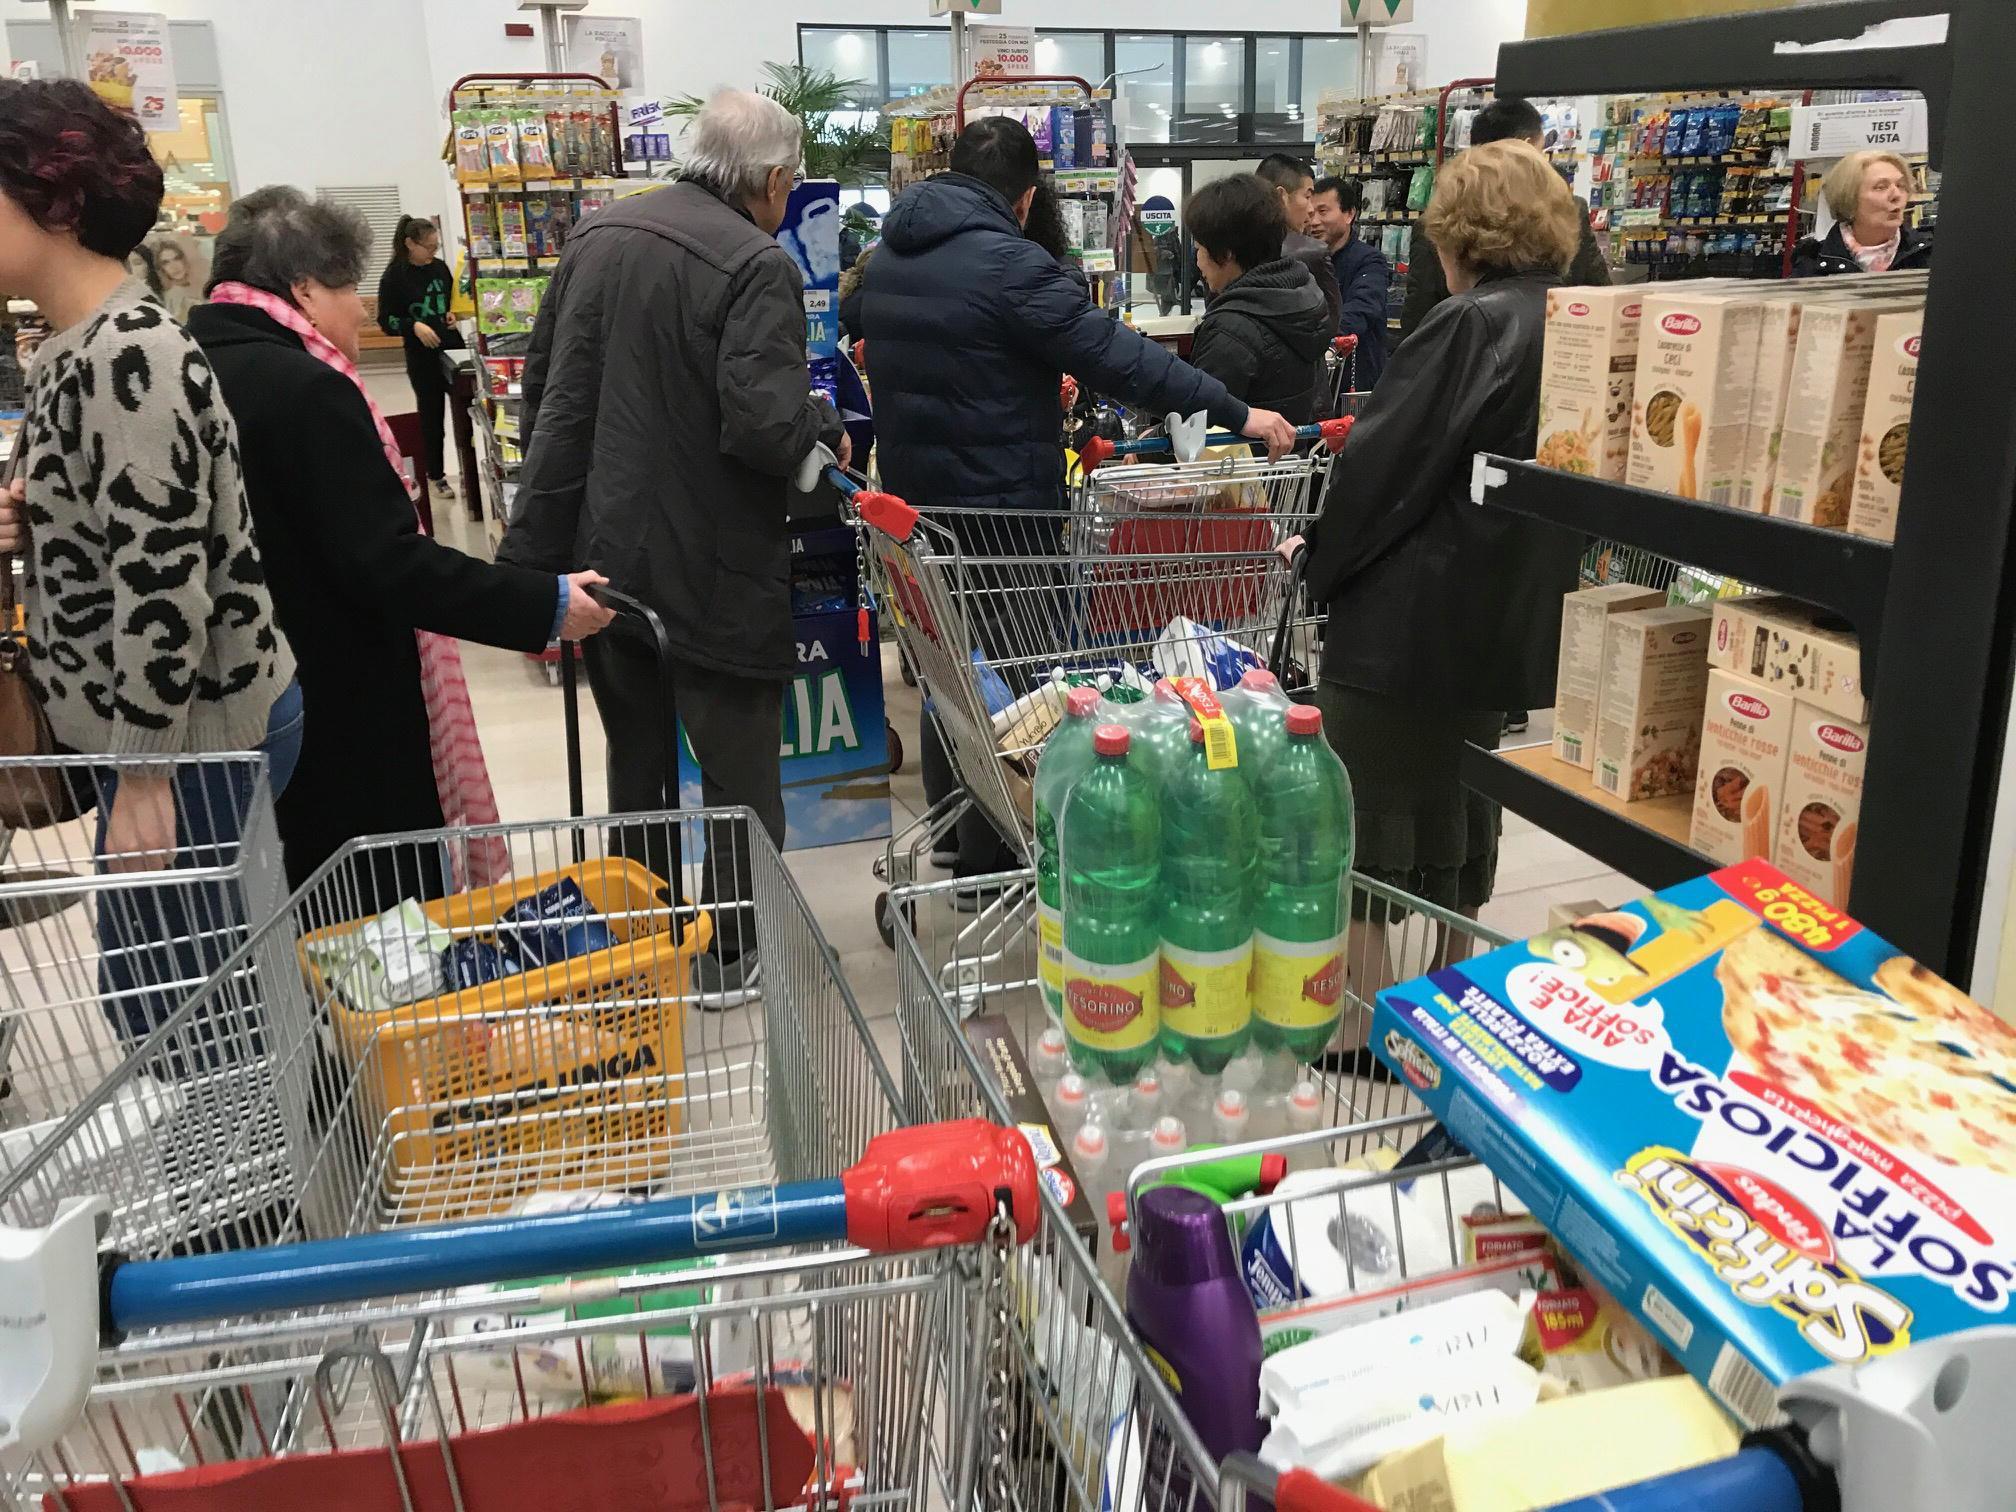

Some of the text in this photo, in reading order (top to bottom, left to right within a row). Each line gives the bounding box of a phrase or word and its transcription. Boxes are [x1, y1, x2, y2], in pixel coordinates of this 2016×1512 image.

[997, 54, 1029, 62] 10.000
[630, 101, 662, 120] FRISK
[1872, 121, 1898, 131] TEST
[1866, 133, 1900, 143] VISTA
[809, 300, 826, 308] 2,49
[1664, 317, 1700, 331] Barilla
[1732, 696, 1768, 717] Barilla
[1822, 727, 1861, 750] Barilla
[1754, 888, 1832, 946] 480g
[1780, 882, 1839, 922] PIZZA
[1067, 988, 1135, 1016] TESORINO
[1529, 991, 1625, 1047] ALTA E
[1412, 1006, 1449, 1041] ITALIA
[1459, 996, 1559, 1075] MOZZARELLA
[1464, 986, 1576, 1075] EXTRA FILANTE
[1762, 1088, 1964, 1221] pizza margherita
[1658, 1050, 2014, 1302] SOFFICIOSA
[1734, 1175, 1823, 1250] Findus
[1482, 1240, 1524, 1251] FORMATO
[1833, 1208, 1896, 1269] LA
[1614, 1157, 1911, 1360] Sofficini
